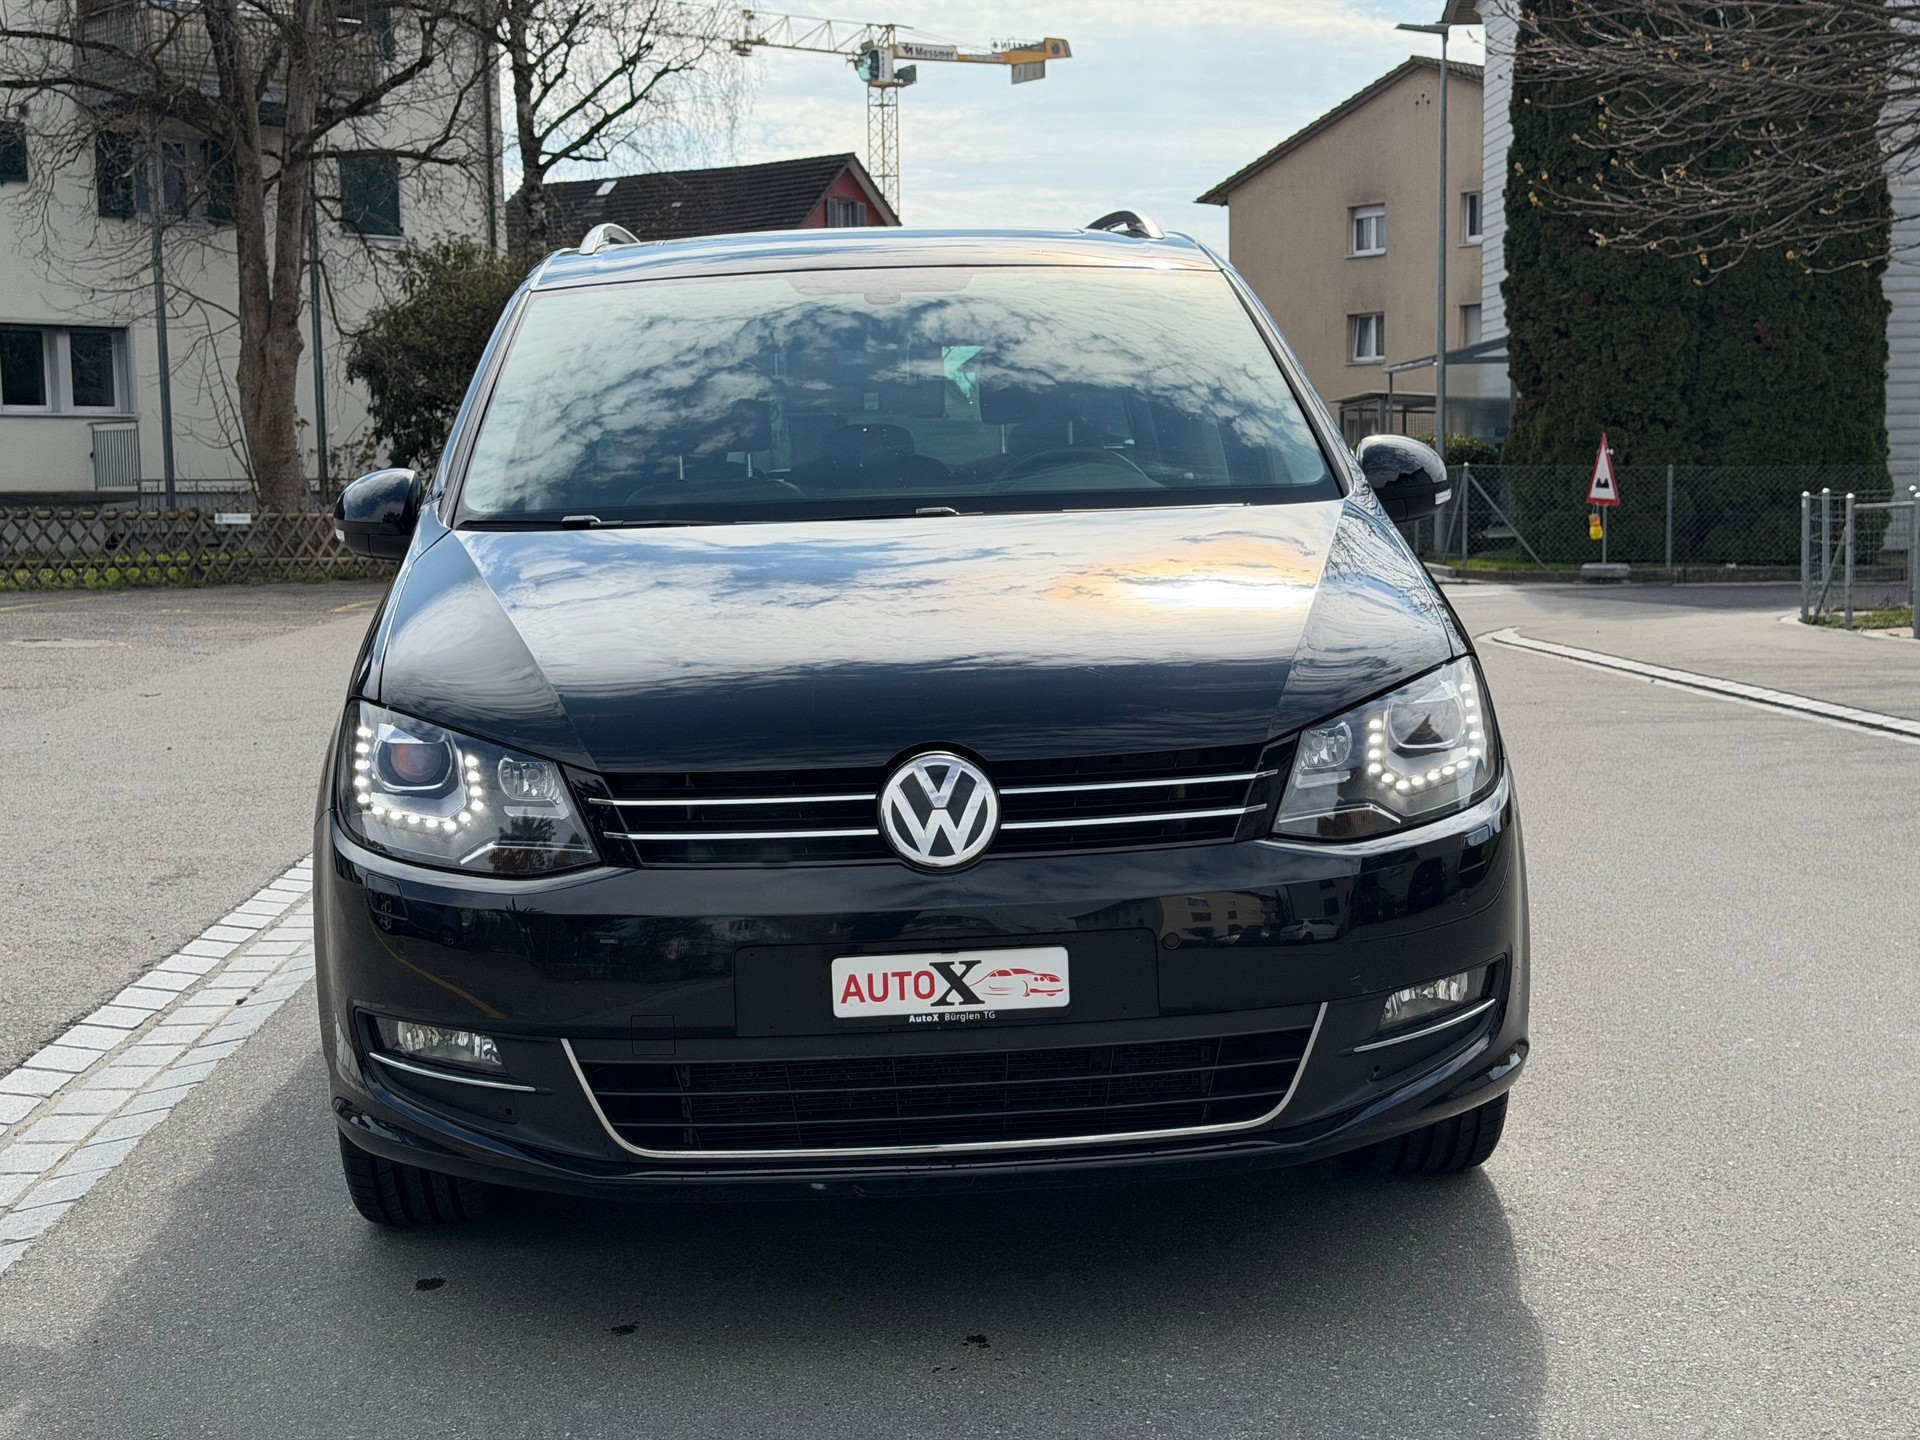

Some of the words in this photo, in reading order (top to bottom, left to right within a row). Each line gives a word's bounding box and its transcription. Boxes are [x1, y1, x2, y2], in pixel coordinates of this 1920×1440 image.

[886, 757, 993, 862] VW
[908, 1014, 940, 1023] AutoX
[944, 1011, 981, 1022] Bürglen
[983, 1010, 996, 1019] TG
